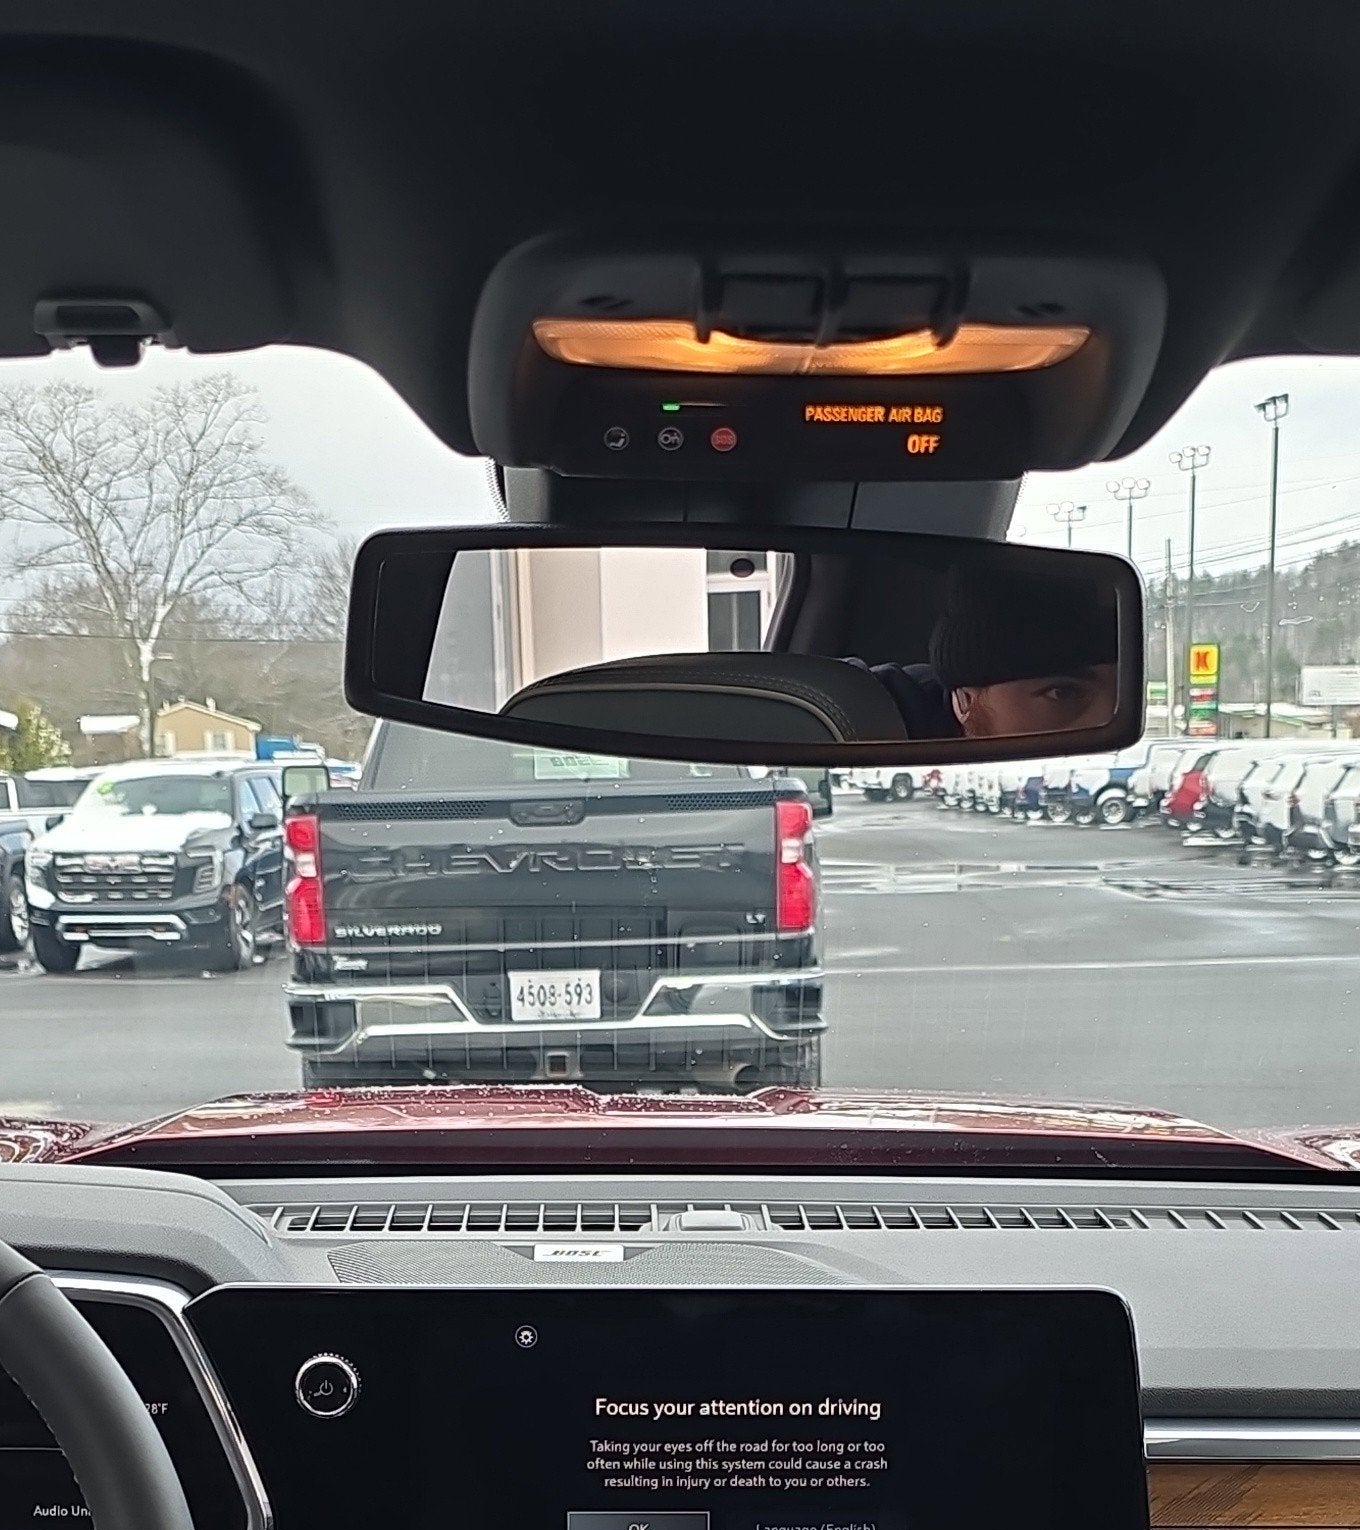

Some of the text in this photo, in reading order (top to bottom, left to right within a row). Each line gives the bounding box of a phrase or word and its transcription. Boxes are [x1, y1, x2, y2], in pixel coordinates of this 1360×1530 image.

[805, 406, 943, 423] PASSENGER AIR BAG
[907, 434, 940, 454] OFF
[348, 843, 744, 883] CHEVROLET
[746, 913, 767, 924] LT
[334, 924, 442, 938] SILVERADO
[543, 1249, 610, 1258] BOSE
[595, 1398, 881, 1420] Focus your attention on driving
[590, 1440, 885, 1456] Taking your eyes off the road for too long or too
[587, 1458, 888, 1473] often while using this system could cause a crash
[604, 1475, 871, 1490] resulting in injury or death to you or others.
[33, 1505, 69, 1517] Audio
